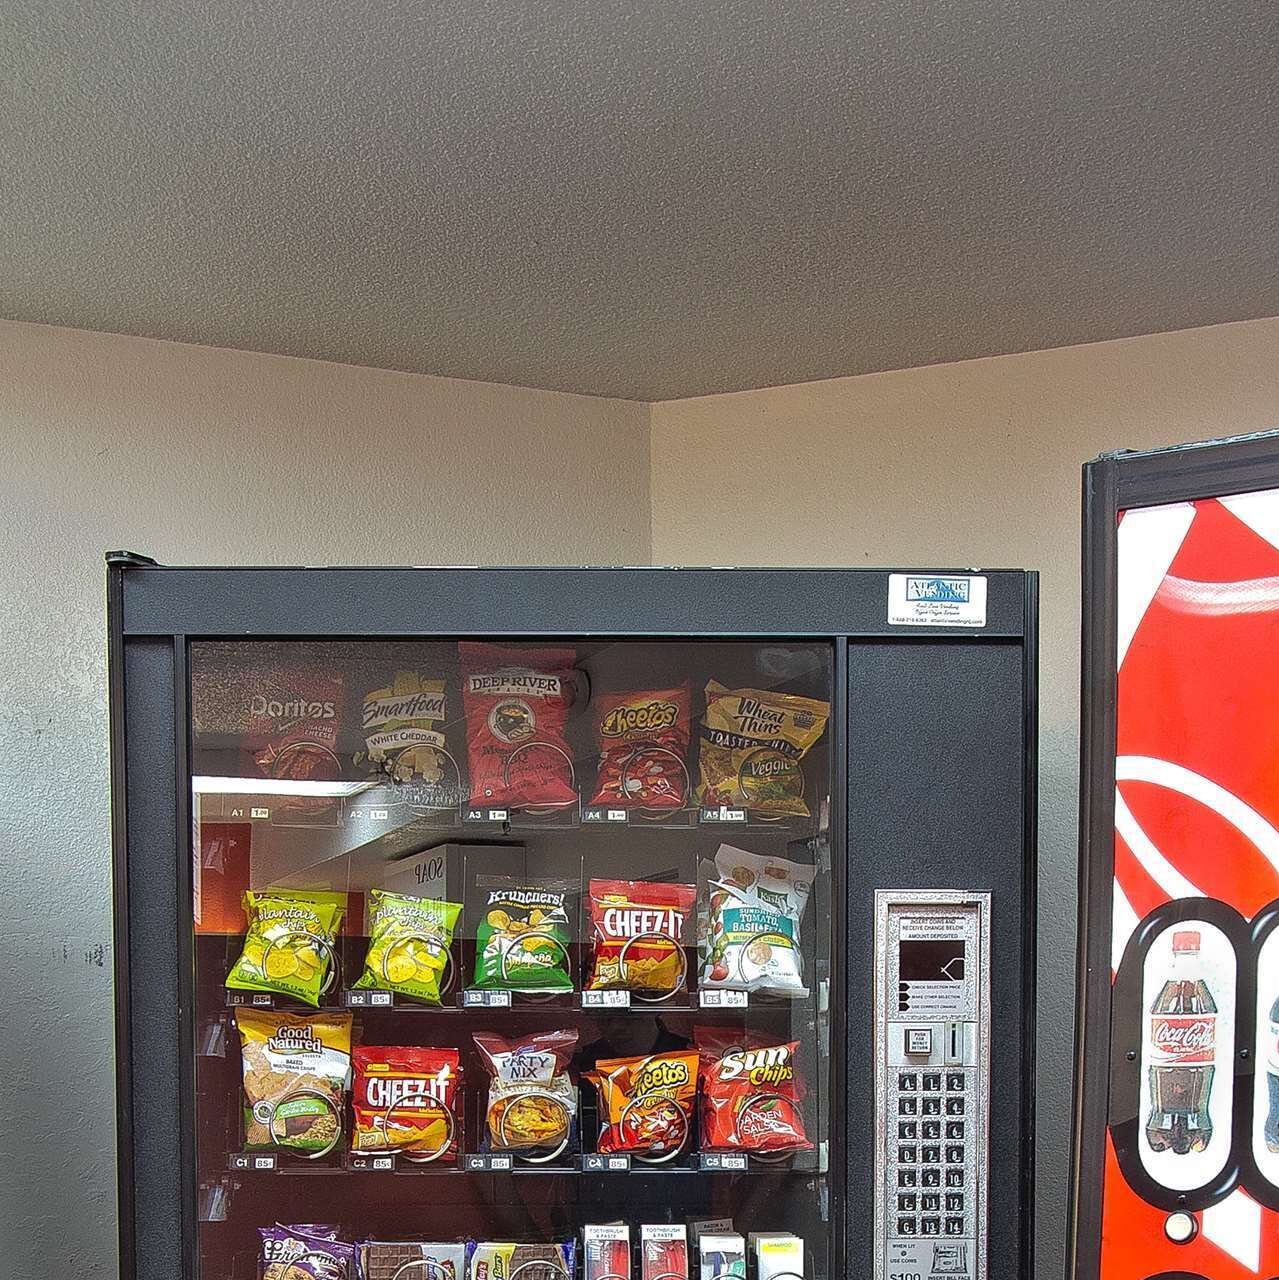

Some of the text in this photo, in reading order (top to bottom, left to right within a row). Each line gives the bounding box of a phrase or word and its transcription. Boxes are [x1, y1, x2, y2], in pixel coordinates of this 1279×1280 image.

[911, 582, 966, 591] ATLANTIC
[914, 590, 966, 599] VENDING
[472, 677, 558, 692] DEEP RIVER
[250, 699, 335, 719] Doritos
[363, 693, 446, 723] Smartfood
[738, 697, 785, 724] Wheat
[733, 715, 781, 734] Thins
[370, 732, 438, 747] WHITE CHEDDAR
[231, 809, 244, 817] A1
[350, 810, 363, 818] A2
[469, 811, 481, 819] A3
[588, 812, 600, 820] A4
[706, 812, 719, 820] A5
[277, 1026, 312, 1041] Good
[268, 1037, 322, 1053] Natured
[502, 1052, 549, 1069] PARTY
[721, 1046, 789, 1079] Sun
[511, 1065, 537, 1079] MIX
[748, 1065, 794, 1087] Chips
[236, 1158, 248, 1167] C1
[353, 1158, 366, 1167] C2
[706, 1157, 719, 1167] C5
